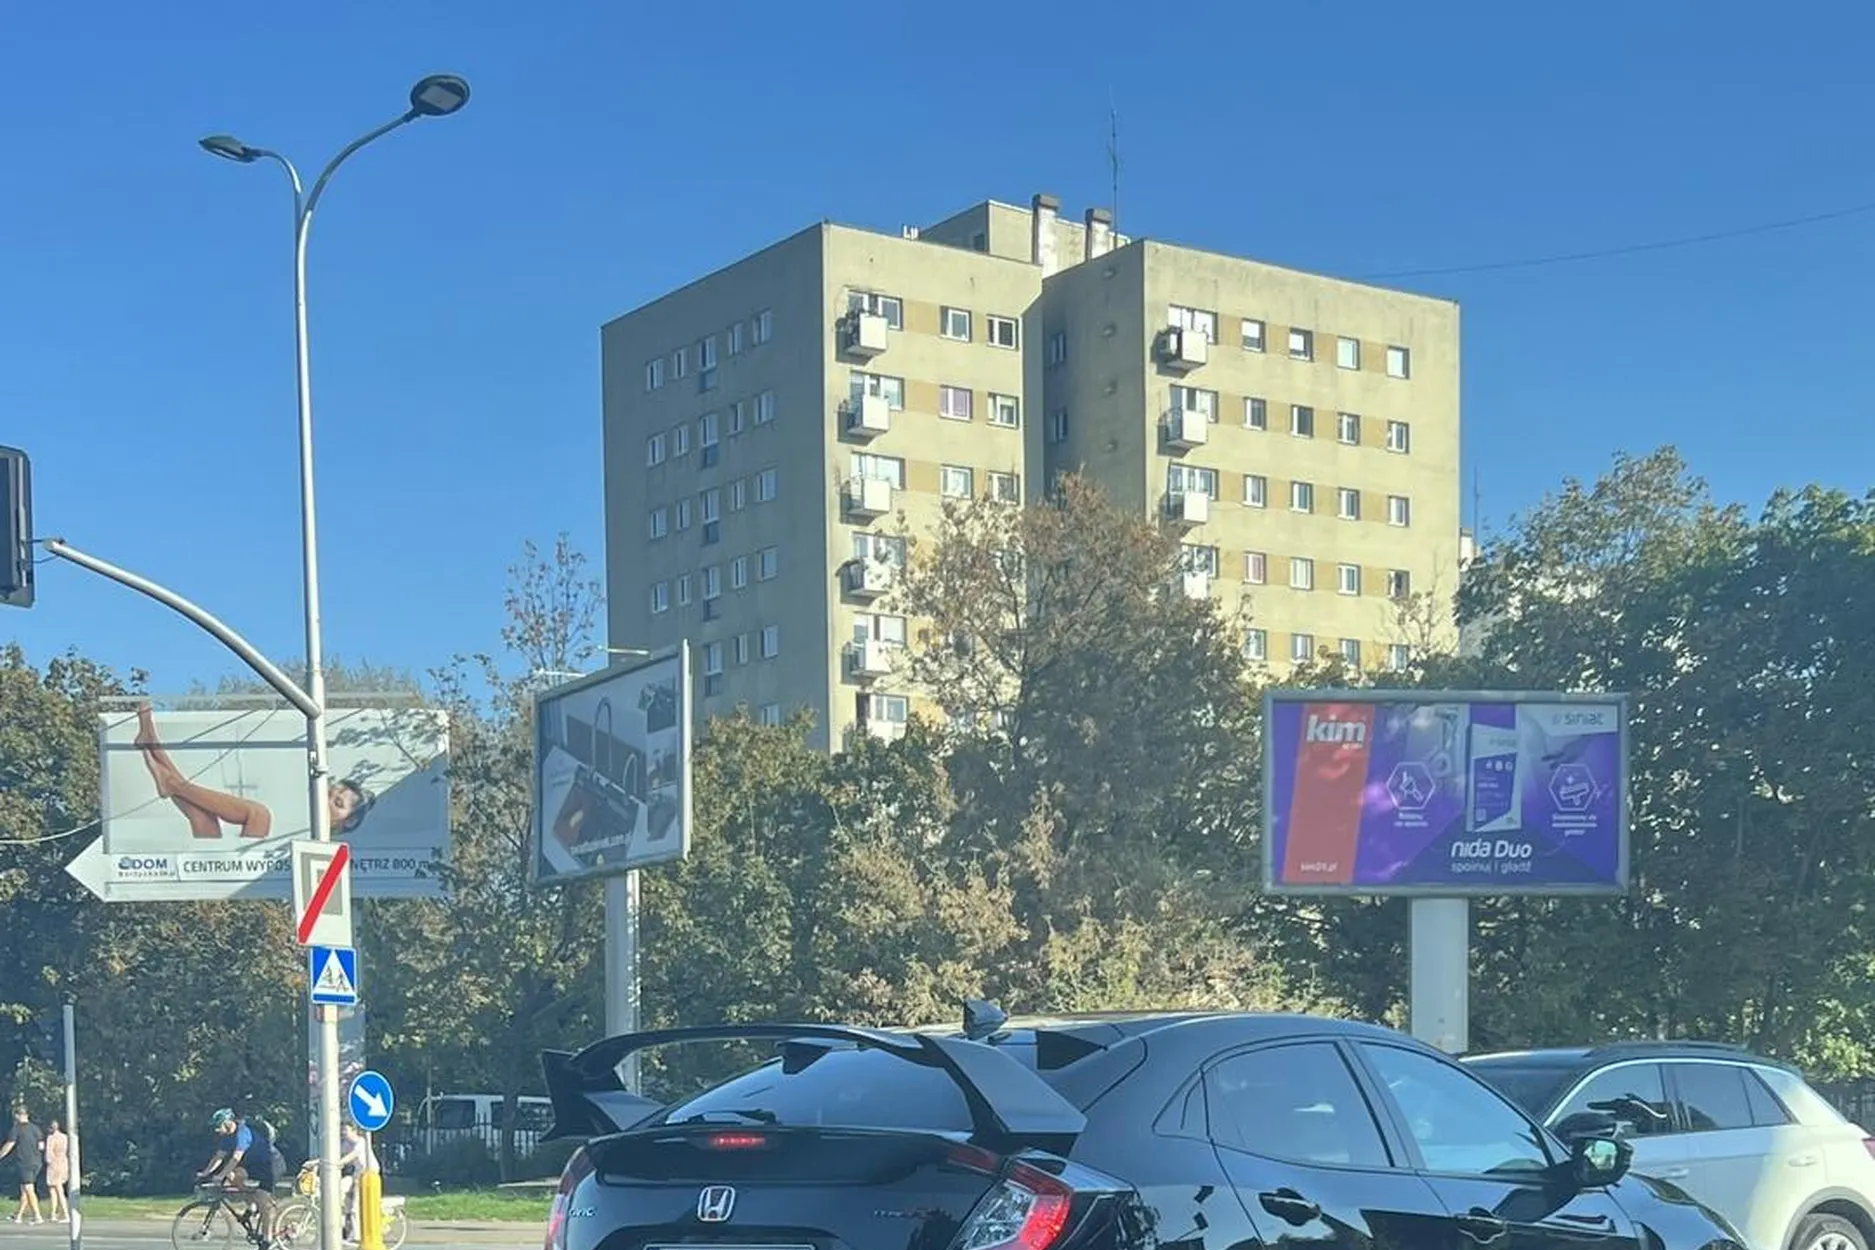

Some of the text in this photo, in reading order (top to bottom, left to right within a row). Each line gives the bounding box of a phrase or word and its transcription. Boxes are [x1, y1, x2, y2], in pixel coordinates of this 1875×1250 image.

[1306, 713, 1366, 743] kim
[1450, 838, 1532, 858] nida Duo
[182, 860, 243, 873] CENTRUM
[393, 858, 416, 870] 800
